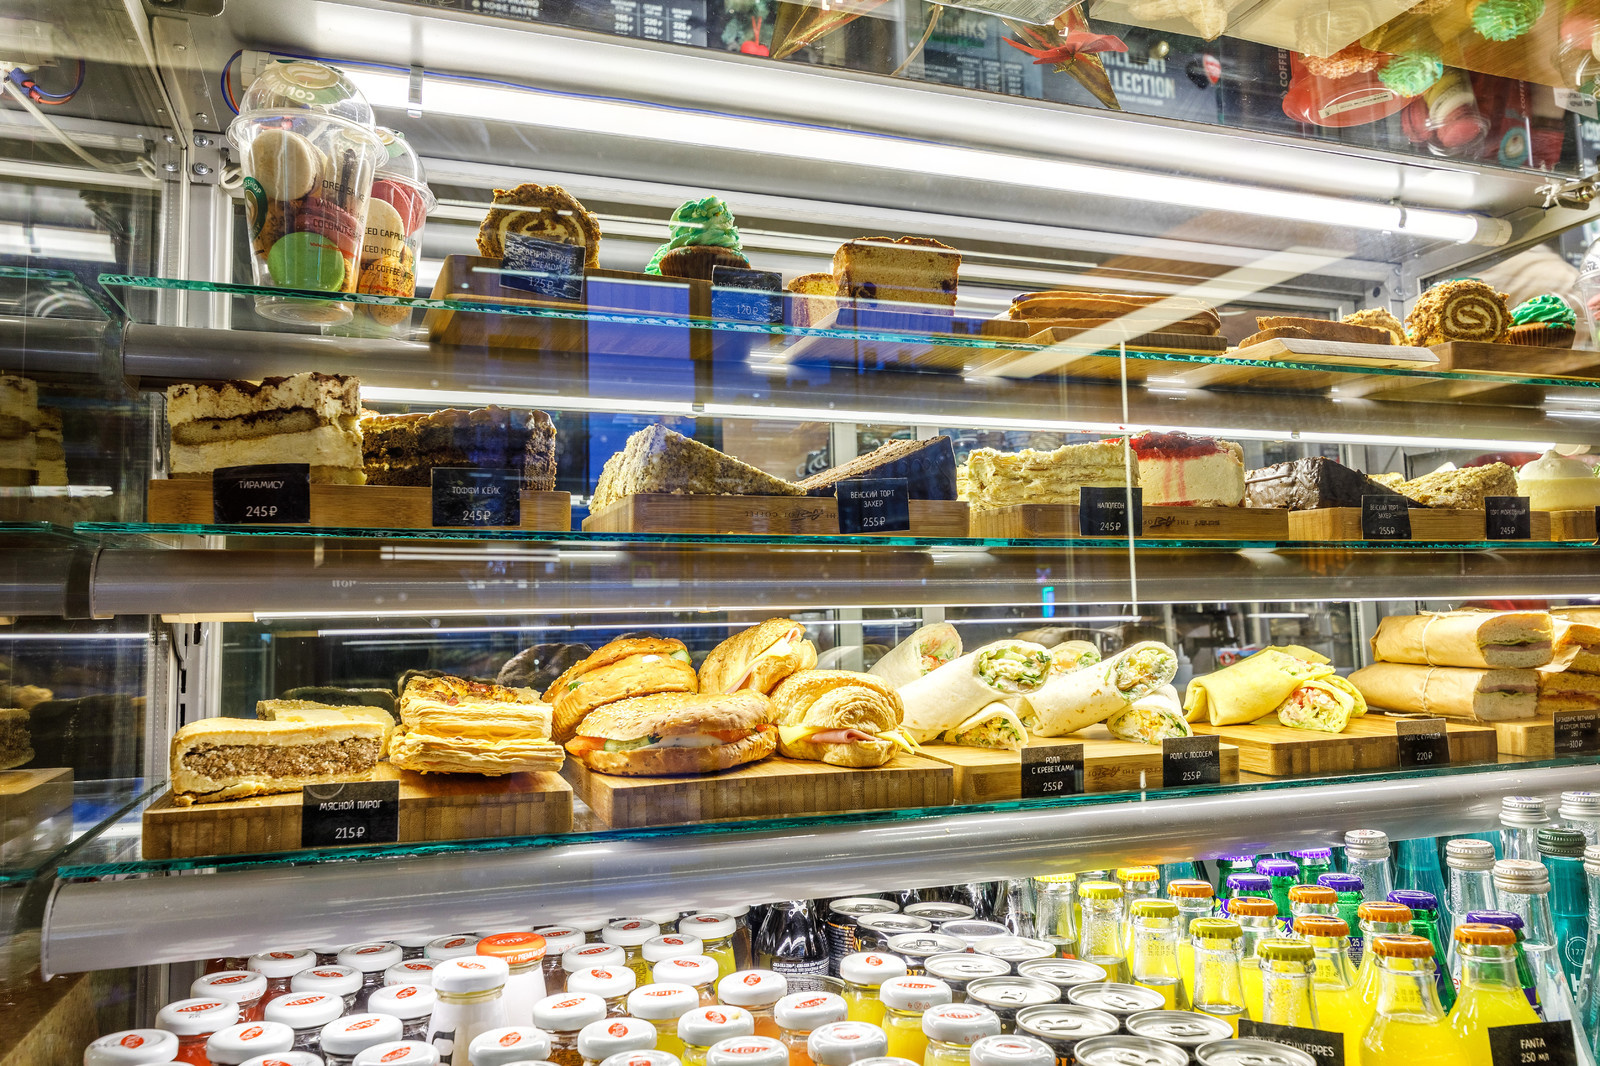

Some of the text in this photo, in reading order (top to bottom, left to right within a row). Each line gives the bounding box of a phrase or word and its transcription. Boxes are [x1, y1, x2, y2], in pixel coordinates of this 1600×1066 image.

[530, 259, 562, 271] КРЕМОМ
[528, 276, 555, 289] 125₽
[736, 304, 759, 316] 120₽
[238, 479, 285, 490] ТИРАМИСУ
[452, 485, 501, 495] ТОФФИ КЕЙК
[850, 489, 895, 499] ВЕНСКИЙ ТОРТ
[863, 500, 884, 508] ЗАХЕР
[245, 505, 278, 518] 245₽
[462, 509, 491, 521] 245₽
[863, 517, 886, 527] 255₽
[1100, 522, 1121, 531] 245₽
[1379, 526, 1396, 535] 255₽
[1500, 526, 1516, 535] 245₽
[1189, 749, 1213, 759] ЛОСОСЕМ
[1416, 751, 1433, 760] 220₽
[1045, 756, 1060, 764] РОЛЛ
[1037, 764, 1075, 774] КРЕВЕТКАМИ
[1182, 771, 1201, 781] 255₽
[1043, 781, 1064, 792] 255₽
[319, 799, 383, 811] МЯСНОЙ ПИРОГ
[335, 826, 366, 839] 215₽
[1520, 1039, 1546, 1050] FANTA
[1520, 1052, 1536, 1063] 250
